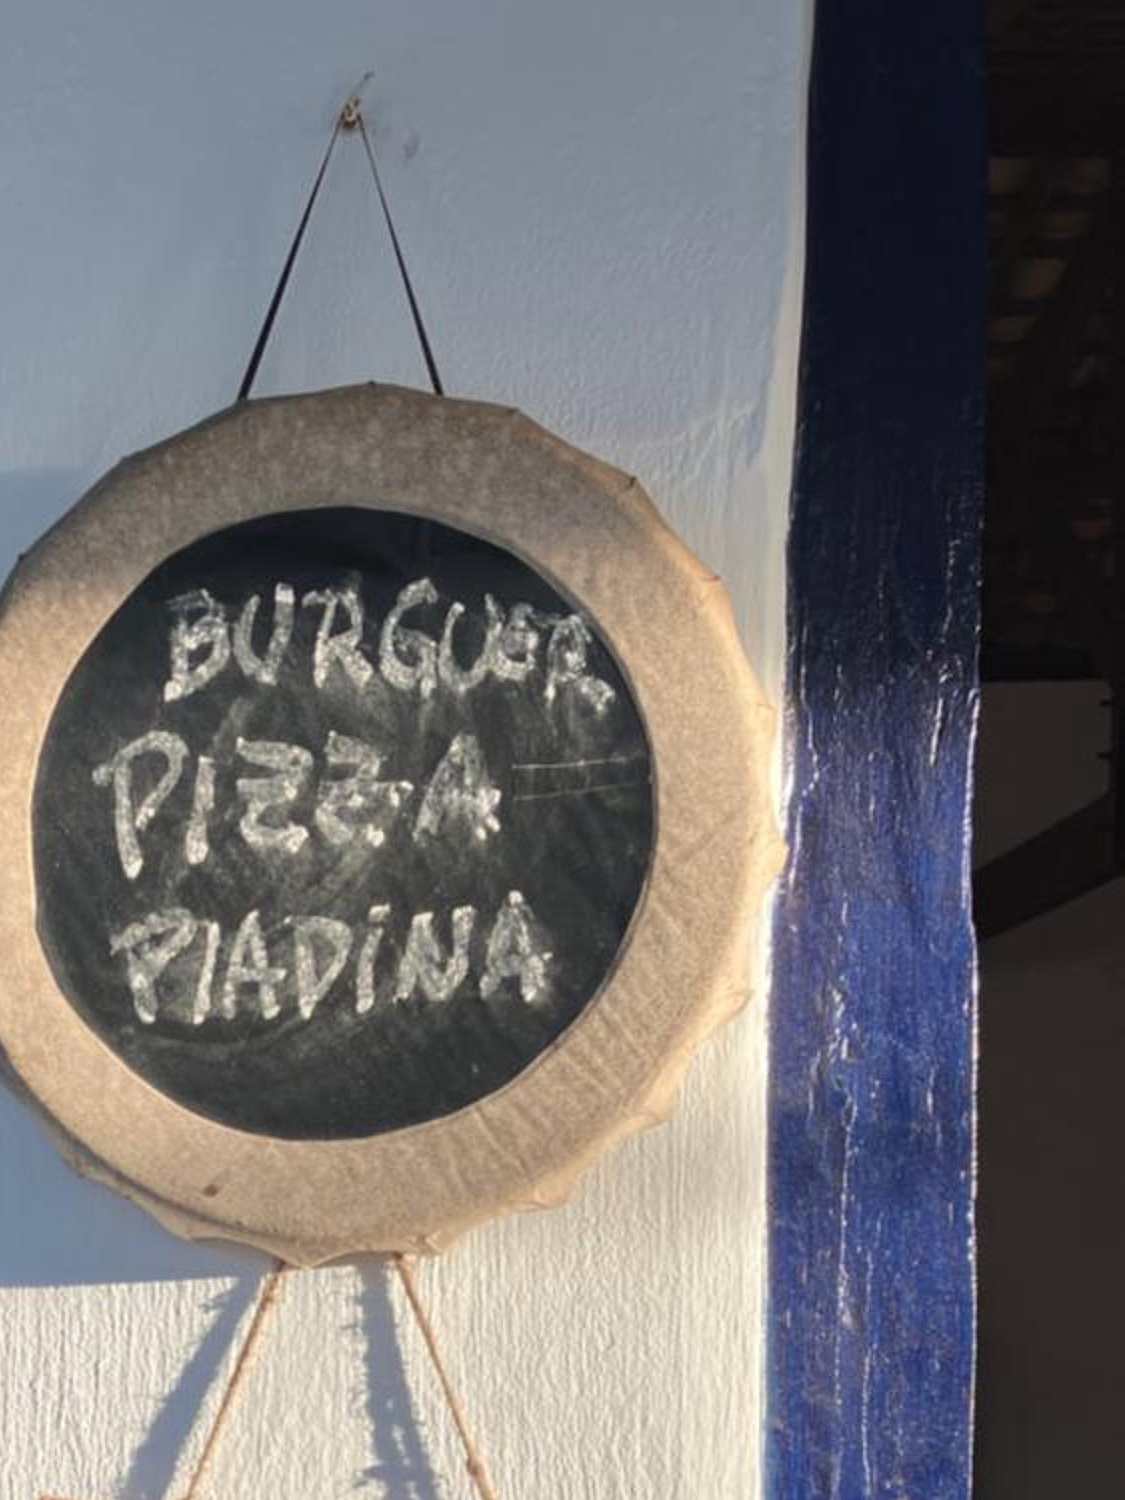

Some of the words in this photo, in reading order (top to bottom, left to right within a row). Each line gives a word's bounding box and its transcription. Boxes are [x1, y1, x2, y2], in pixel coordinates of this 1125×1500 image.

[164, 578, 617, 714] BURGUER
[92, 730, 503, 880] PIZZA
[108, 891, 554, 1025] PIADINA
